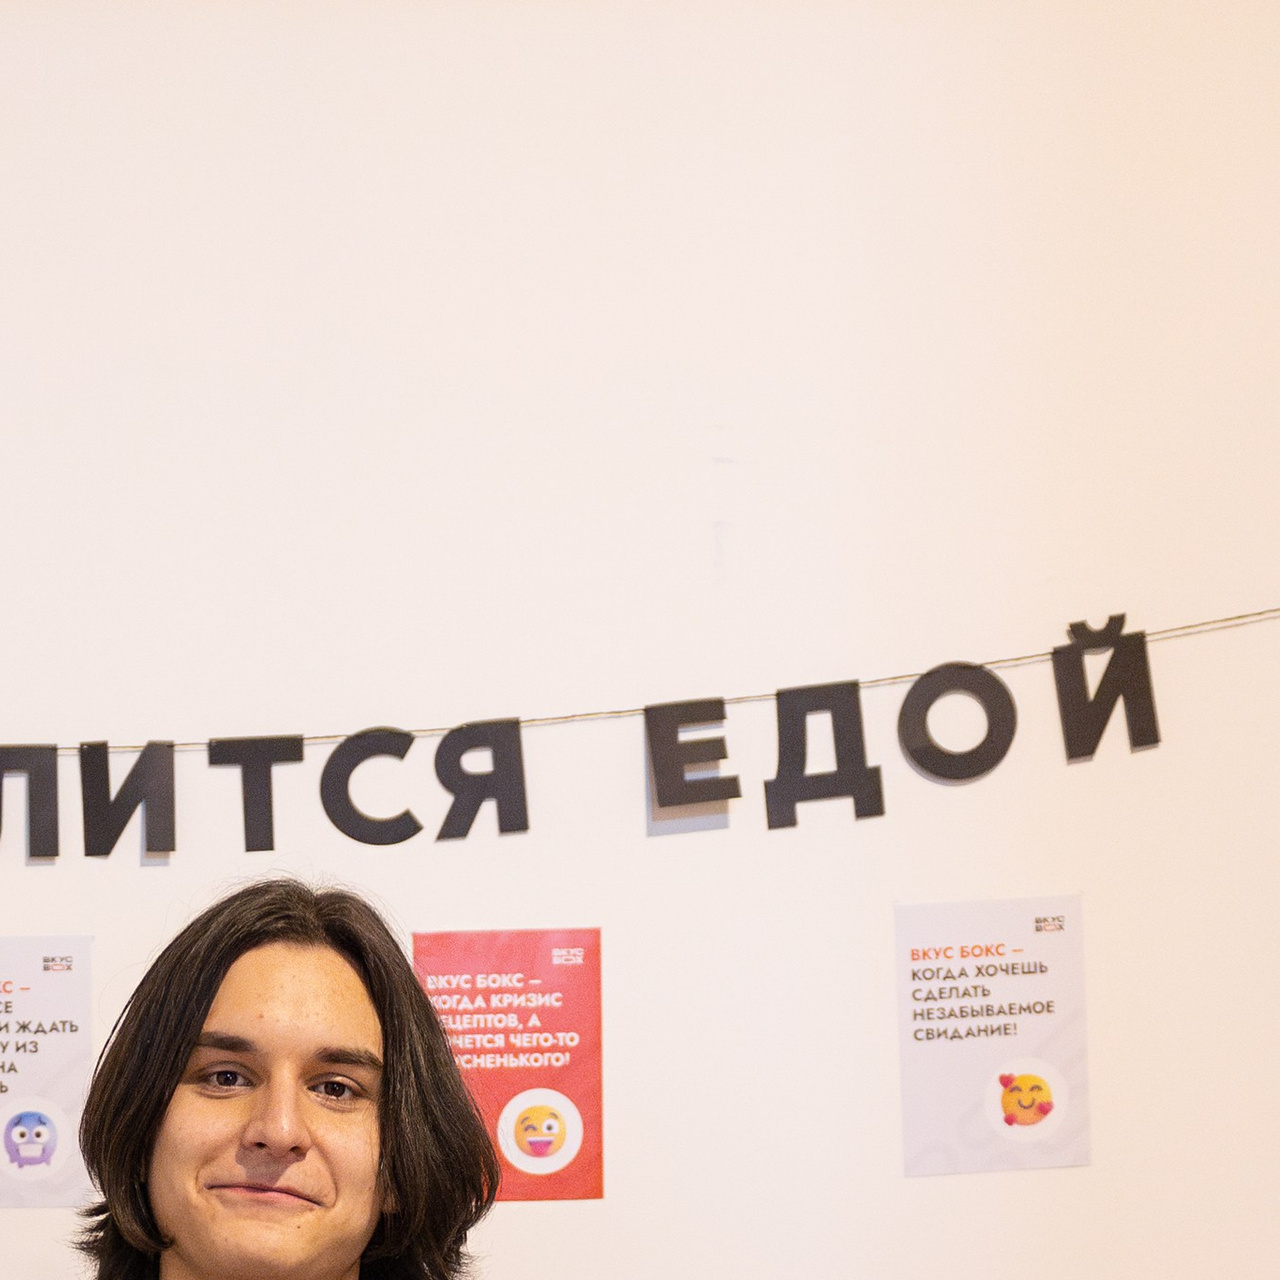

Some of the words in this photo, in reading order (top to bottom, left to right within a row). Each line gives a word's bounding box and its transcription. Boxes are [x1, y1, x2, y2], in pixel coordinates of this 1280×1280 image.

[644, 613, 1161, 829] ЕДОЙ
[911, 947, 954, 961] ВКУС
[960, 943, 1006, 958] БОКС
[912, 967, 969, 981] КОГДА
[975, 961, 1048, 978] ХОЧЕШЬ
[427, 975, 472, 989] ВКУС
[476, 973, 524, 988] БОКС
[490, 993, 563, 1008] КРИЗИС
[912, 985, 991, 1002] СДЕЛАТЬ
[913, 1000, 1055, 1021] НЕЗАБЫВАЕМОЕ
[16, 1020, 79, 1034] ЖДАТЬ
[441, 1013, 524, 1030] ЕЦЕПТОВ,
[528, 1013, 541, 1027] А
[913, 1022, 1017, 1041] СВИДАНИЕ!
[15, 1041, 39, 1053] ИЗ
[450, 1033, 505, 1049] ЧЕТСЯ
[509, 1032, 579, 1048] ЧЕГО-ТО
[456, 1052, 570, 1068] СНЕНЬКОГО!
